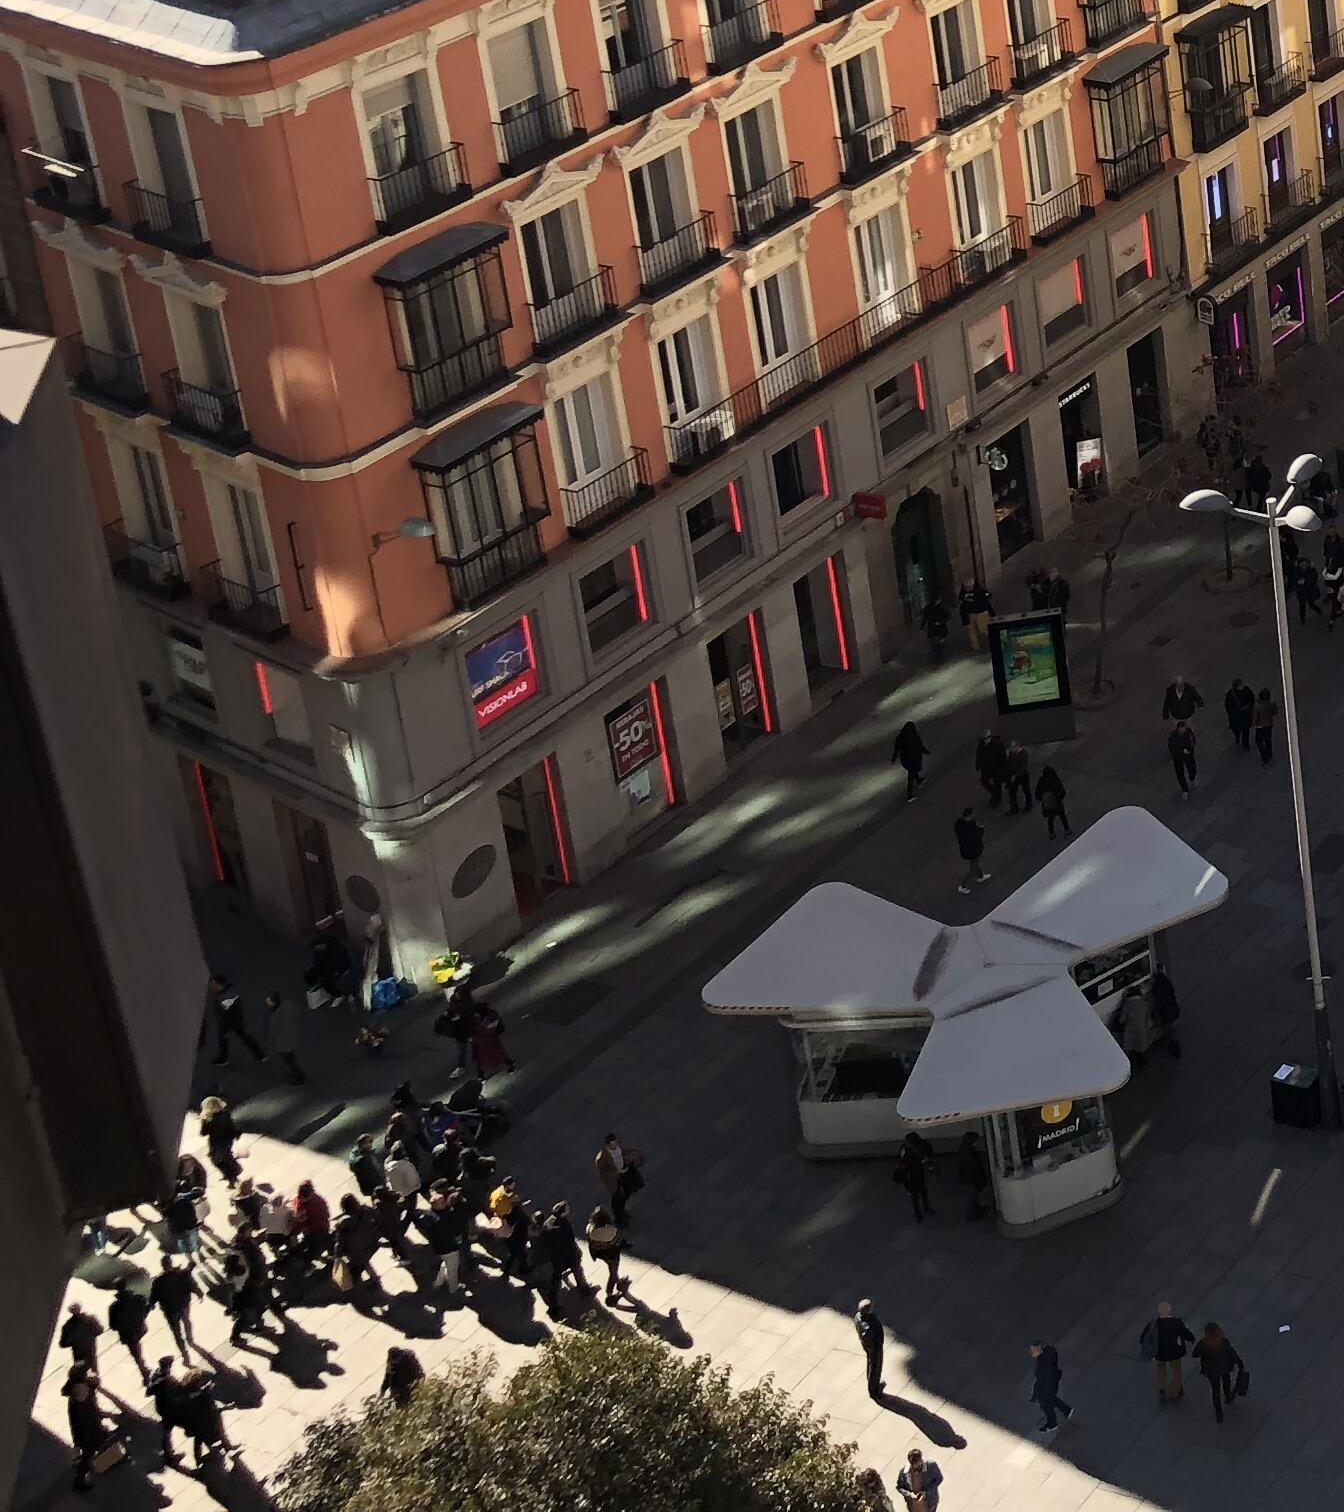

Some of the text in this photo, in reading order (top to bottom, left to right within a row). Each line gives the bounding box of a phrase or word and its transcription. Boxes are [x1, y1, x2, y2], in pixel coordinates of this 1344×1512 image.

[1318, 210, 1341, 229] TACO
[1264, 247, 1289, 267] TACO
[478, 681, 528, 717] VISIONLAB
